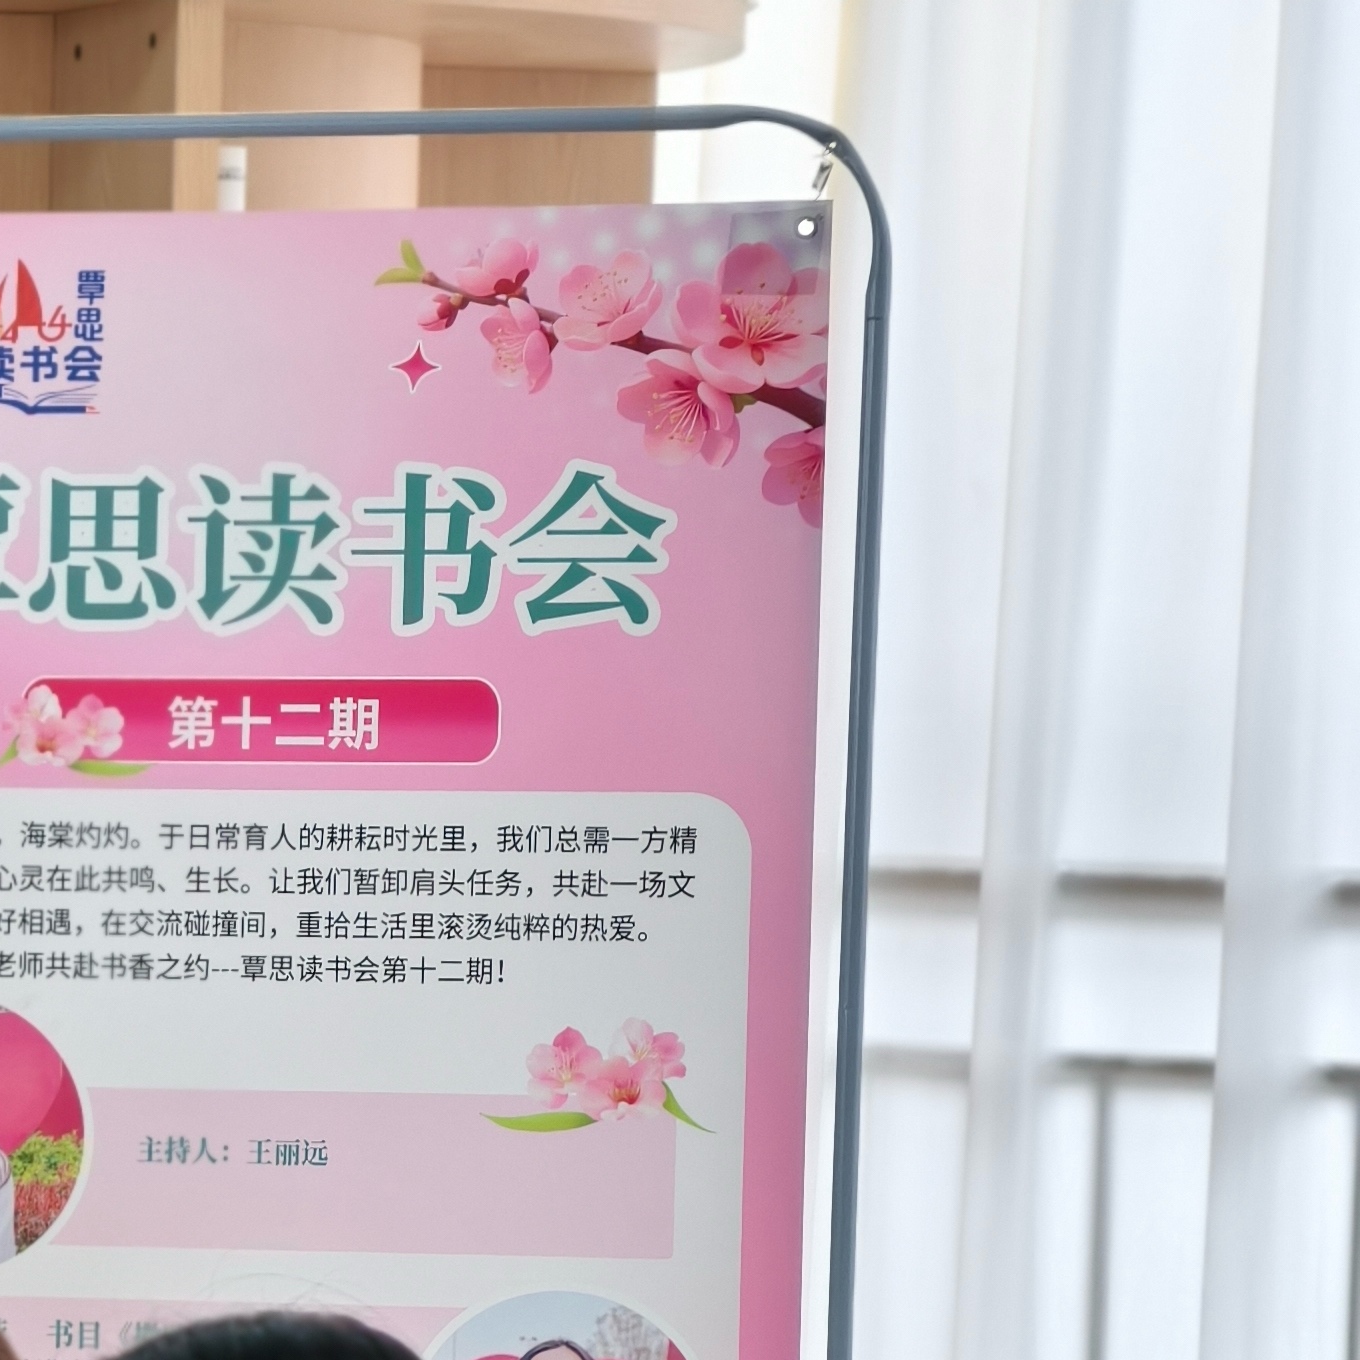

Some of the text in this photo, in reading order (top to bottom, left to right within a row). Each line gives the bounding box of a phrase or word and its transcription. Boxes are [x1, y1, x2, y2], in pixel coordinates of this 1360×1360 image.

[75, 269, 106, 342] 覃思
[167, 696, 381, 751] 第十二期
[137, 1135, 329, 1166] 主持人：王丽远
